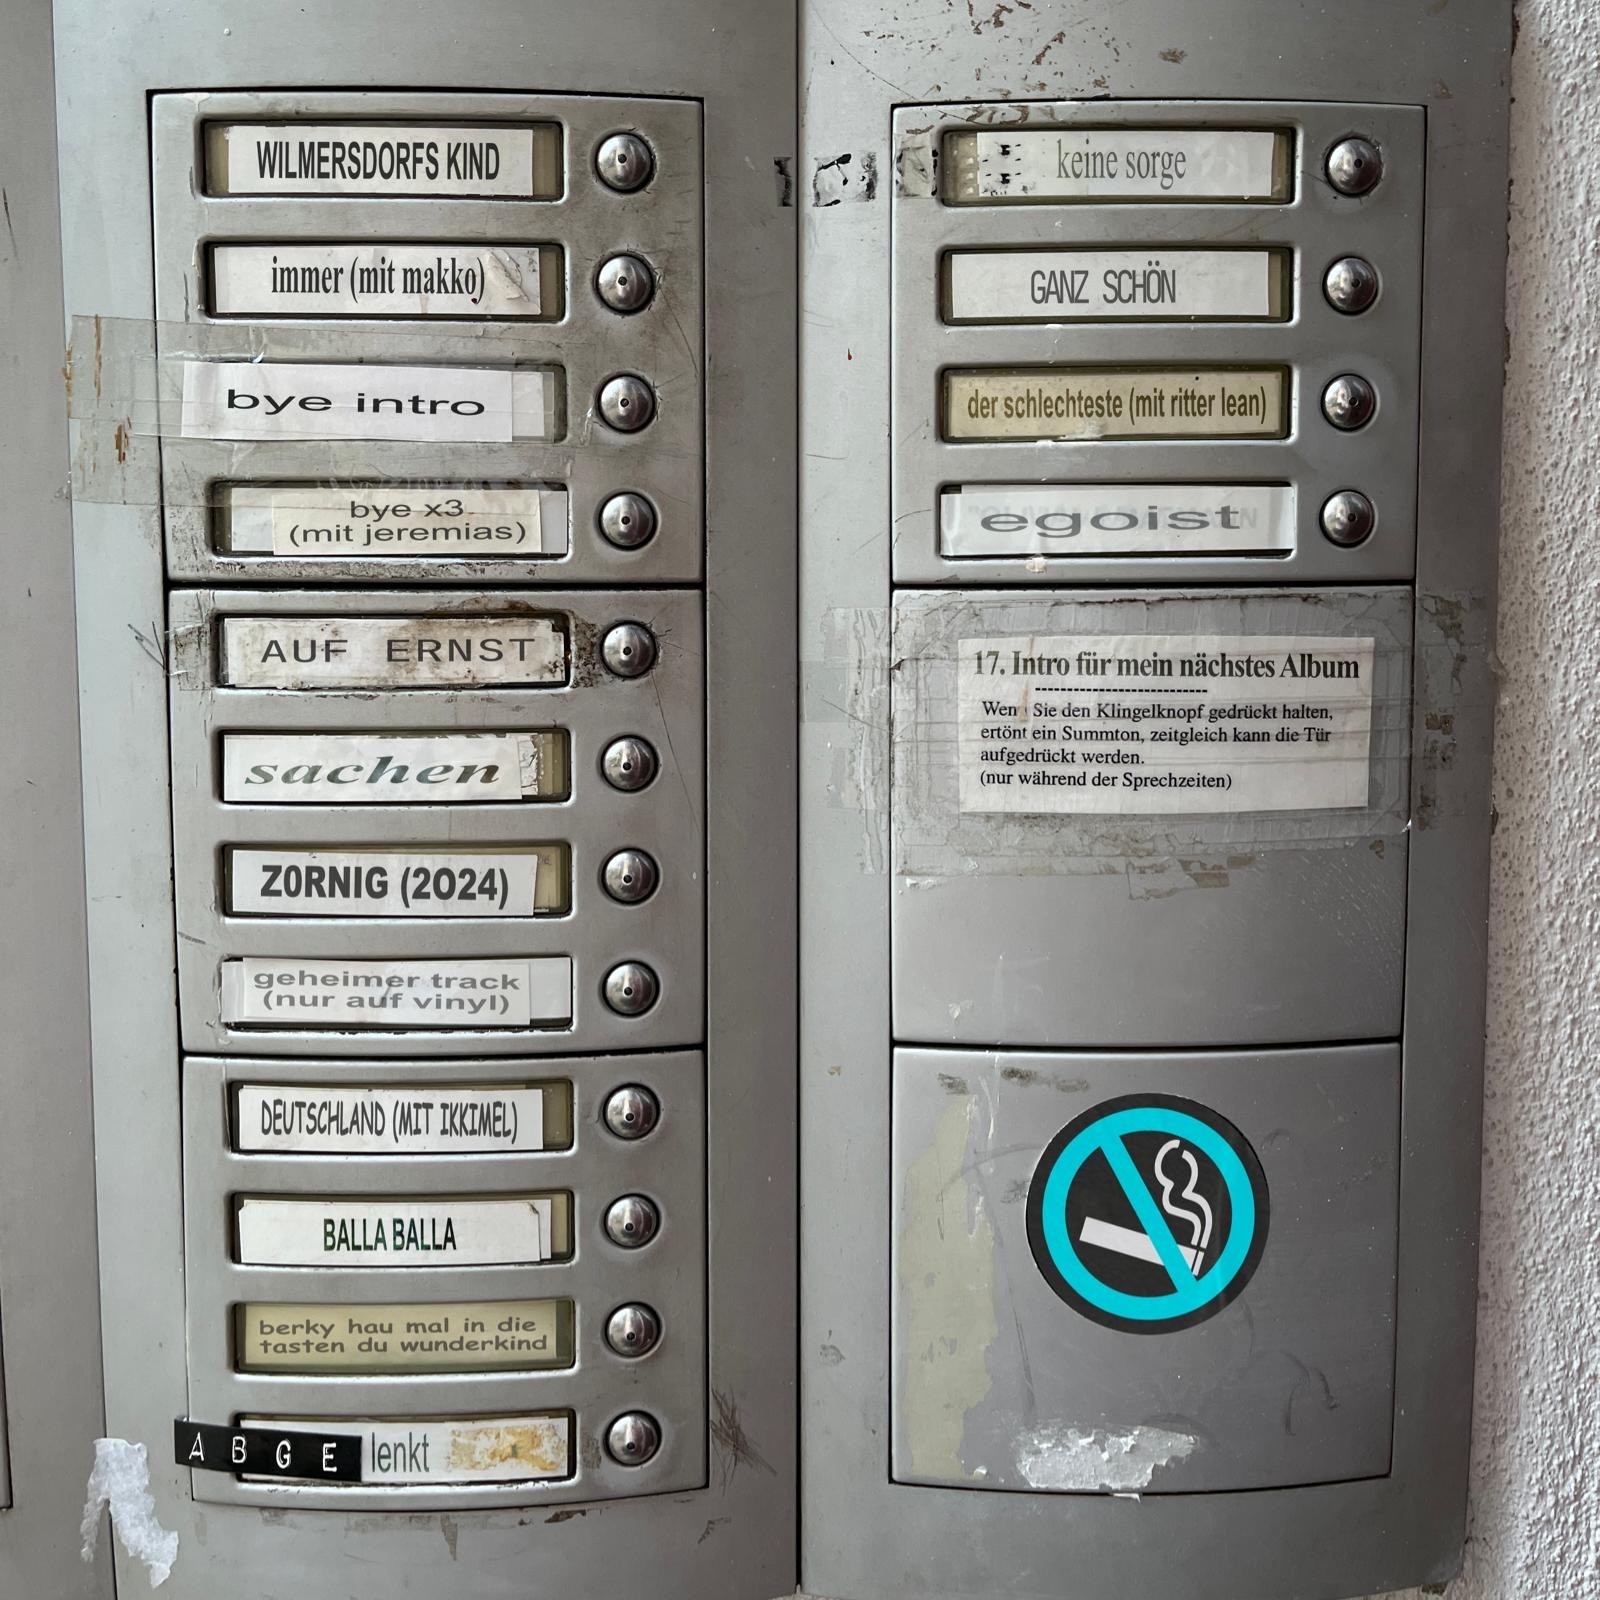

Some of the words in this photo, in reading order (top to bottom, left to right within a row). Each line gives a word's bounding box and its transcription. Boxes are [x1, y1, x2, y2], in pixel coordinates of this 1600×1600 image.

[256, 141, 439, 180] WILMERSDORFS
[447, 142, 500, 180] KIND
[1056, 139, 1118, 179] keine
[1126, 149, 1186, 188] sorge
[271, 255, 344, 294] immer
[350, 255, 396, 303] (mit
[402, 256, 485, 304] makko)
[1030, 270, 1088, 304] GANZ
[1102, 261, 1176, 304] SCHÖN
[227, 388, 332, 412] bye
[356, 392, 485, 416] intro
[968, 391, 998, 419] der
[1004, 389, 1123, 420] schlechteste
[1129, 388, 1165, 426] (mit
[1170, 387, 1215, 418] ritter
[1221, 386, 1266, 424] lean)
[350, 500, 417, 521] bye
[424, 498, 464, 516] x3
[980, 506, 1240, 537] egoist
[289, 523, 357, 544] (mit
[363, 521, 526, 545] jeremias)
[261, 639, 348, 663] AUF
[387, 638, 535, 662] ERNST
[974, 650, 1005, 676] 17.
[1012, 651, 1069, 676] Intro
[1076, 651, 1112, 677] für
[1117, 652, 1173, 677] mein
[1180, 652, 1275, 678] nächstes
[1280, 653, 1359, 679] Album
[1033, 702, 1057, 718] Sie
[1062, 702, 1091, 719] den
[1097, 703, 1205, 721] Klingelknopf
[1209, 704, 1278, 722] gedrückt
[1282, 704, 1333, 722] halten,
[981, 725, 1027, 740] ertönt
[1032, 727, 1057, 741] ein
[1062, 726, 1145, 744] Summton,
[1150, 727, 1227, 745] zeitgleich
[1232, 727, 1271, 741] kann
[1275, 727, 1300, 742] die
[1303, 727, 1330, 742] Tür
[245, 755, 500, 784] sachen
[981, 747, 1076, 765] aufgedrückt
[1080, 749, 1145, 764] werden.
[980, 771, 1014, 787] (nur
[1018, 771, 1087, 787] während
[1091, 772, 1118, 787] der
[1122, 771, 1232, 790] Sprechzeiten)
[254, 970, 420, 989] geheimer
[430, 973, 520, 990] track
[263, 990, 335, 1010] (nur
[346, 991, 404, 1009] auf
[411, 993, 510, 1014] vinyl)
[261, 1099, 385, 1136] DEUTSCHLAND
[393, 1100, 434, 1143] (MIT
[440, 1101, 518, 1144] IKKIMEL)
[323, 1218, 387, 1251] BALLA
[393, 1217, 457, 1251] BALLA
[260, 1319, 335, 1337] berky
[348, 1318, 392, 1334] hau
[406, 1316, 449, 1333] mal
[463, 1316, 485, 1333] in
[497, 1316, 536, 1332] die
[259, 1338, 345, 1353] tasten
[357, 1336, 388, 1352] du
[400, 1333, 547, 1352] wunderkind
[371, 1433, 430, 1472] lenkt
